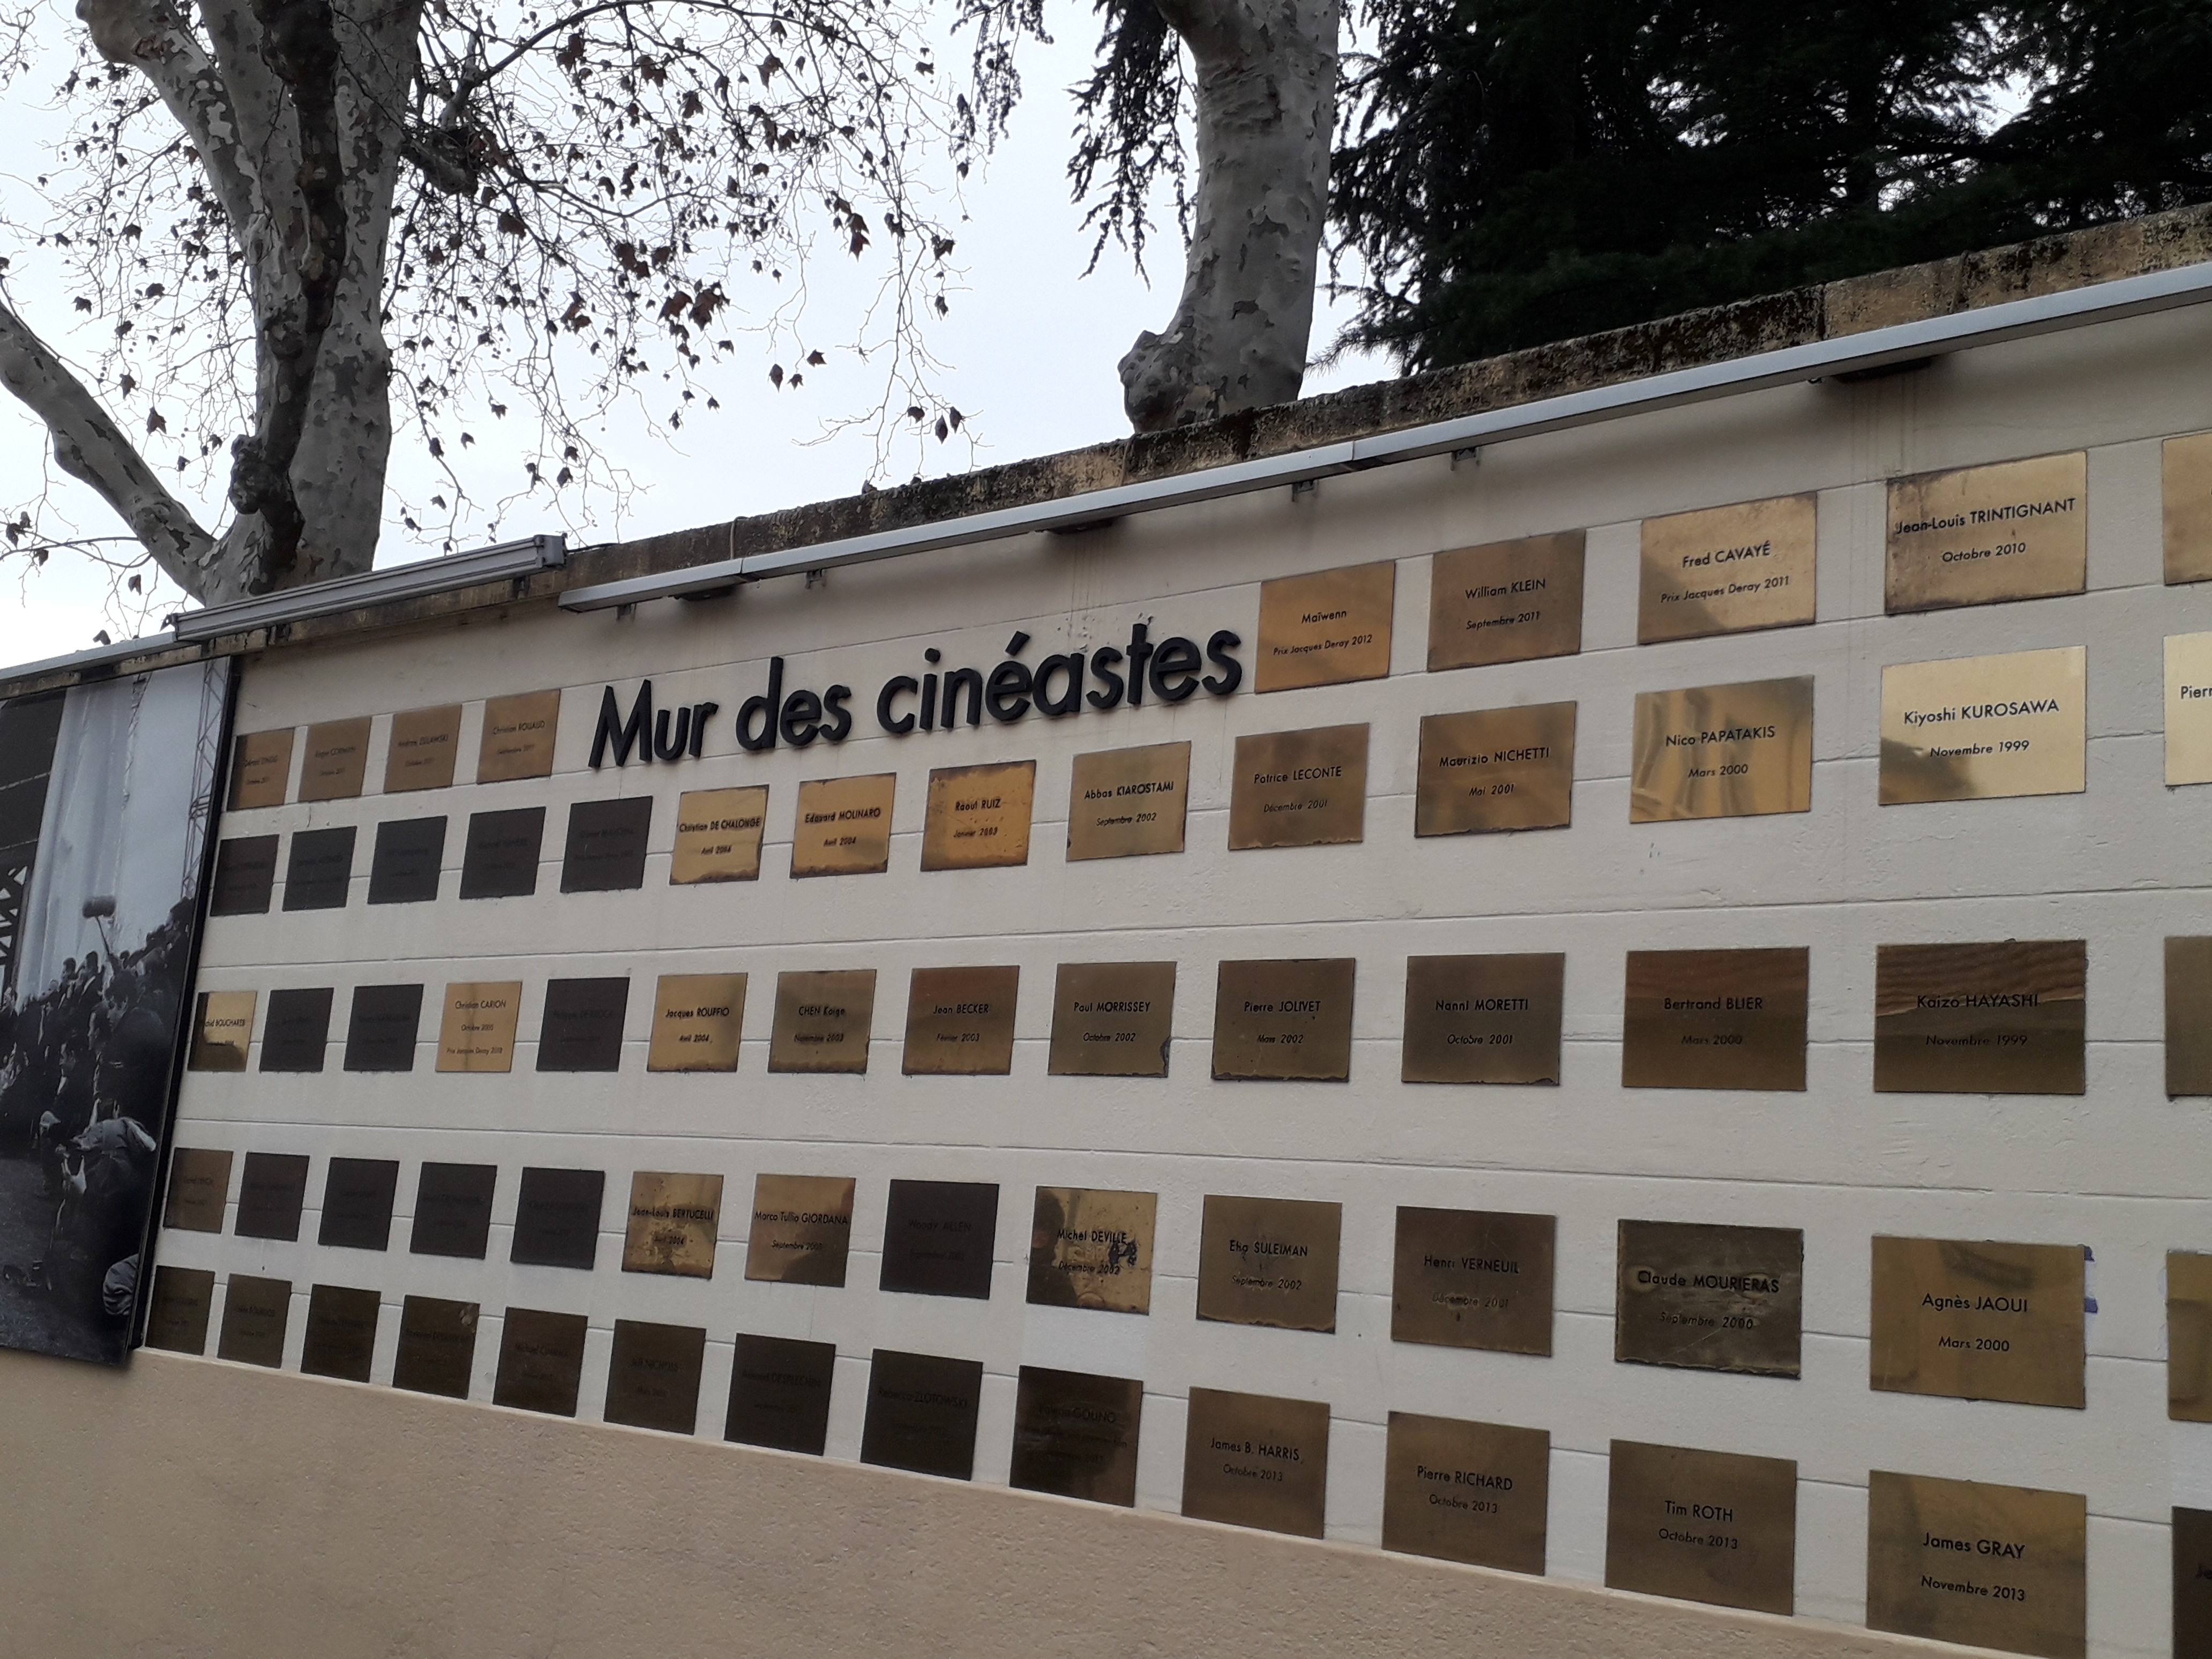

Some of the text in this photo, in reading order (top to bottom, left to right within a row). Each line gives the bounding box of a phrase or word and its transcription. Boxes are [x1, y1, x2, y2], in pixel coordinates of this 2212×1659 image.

[1897, 497, 2076, 534] Jean-Louis TRINTIGNANT
[1682, 540, 1771, 568] Fred CAVAYÉ
[1941, 542, 2026, 562] Octobre 2010
[1465, 578, 1546, 600] William KLEIN
[1661, 574, 1790, 603] Prix Jacques Deray 2011
[1466, 611, 1541, 631] Septembre 2011
[1273, 634, 1373, 656] Prix Jacques Deray 2012
[588, 622, 1243, 769] Mur des cinéastes
[1903, 699, 2060, 727] Kiyoshi KUROSAWA
[1665, 726, 1776, 747] Nico PAPATAKIS
[1439, 746, 1550, 768] Maurizio NICHETTI
[1930, 740, 2029, 757] Novembre 1999
[1253, 766, 1342, 784] Patrice LECONTE
[1688, 764, 1748, 778] Mars 2000
[1084, 781, 1174, 800] Abbas KIAROSTAMI
[1468, 783, 1515, 797] Mai 2001
[839, 806, 881, 820] MOLINARO
[955, 799, 1001, 811] Raoul RUIZ
[1264, 799, 1327, 813] Décembre 2001
[710, 820, 720, 831] DE
[1096, 812, 1156, 826] Septembre 2002
[933, 1004, 989, 1014] Jean BECKER
[1074, 1002, 1150, 1012] Paul MORRISSEY
[1244, 1000, 1321, 1012] Pierre JOLIVET
[1436, 999, 1529, 1011] Nanni MORETTI
[1664, 997, 1763, 1010] Bertrand BLIER
[1917, 994, 2038, 1008] Kaizo HAYASHI
[665, 1006, 729, 1019] Jacques ROUFFIO
[798, 1005, 846, 1017] CHEN Kaige
[961, 1034, 980, 1042] 2003
[1083, 1032, 1137, 1042] Octobre 2002
[1280, 1034, 1304, 1044] 2002
[1447, 1034, 1513, 1044] Octobre 2001
[1682, 1035, 1743, 1045] Mars 2000
[1926, 1035, 2027, 1046] Novembre 1999
[754, 1210, 778, 1221] Marco
[801, 1213, 848, 1225] GIORDANA
[1057, 1229, 1127, 1243] Michel DEVILLE
[1229, 1238, 1308, 1257] Elia SULEIMAN
[1424, 1254, 1519, 1274] Henri VERNEUIL
[1231, 1275, 1302, 1290] Septembre 2002
[1638, 1270, 1780, 1293] Claude MOURIERAS
[1484, 1296, 1508, 1309] 2001
[1922, 1293, 2028, 1312] Agnès JAOUI
[1659, 1312, 1753, 1329] Septembre 2000
[1938, 1335, 2010, 1352] Mars 2000
[1210, 1437, 1241, 1454] James
[1258, 1444, 1299, 1461] HARRIS
[1223, 1463, 1283, 1482] Octobre 2013
[1416, 1465, 1513, 1491] Pierre RICHARD
[1429, 1493, 1499, 1514] Octobre 2013
[1665, 1500, 1733, 1522] Tim ROTH
[1658, 1528, 1738, 1550] Octobre 2013
[1923, 1533, 2027, 1559] James GRAY
[1920, 1575, 2026, 1602] Novembre 2013
